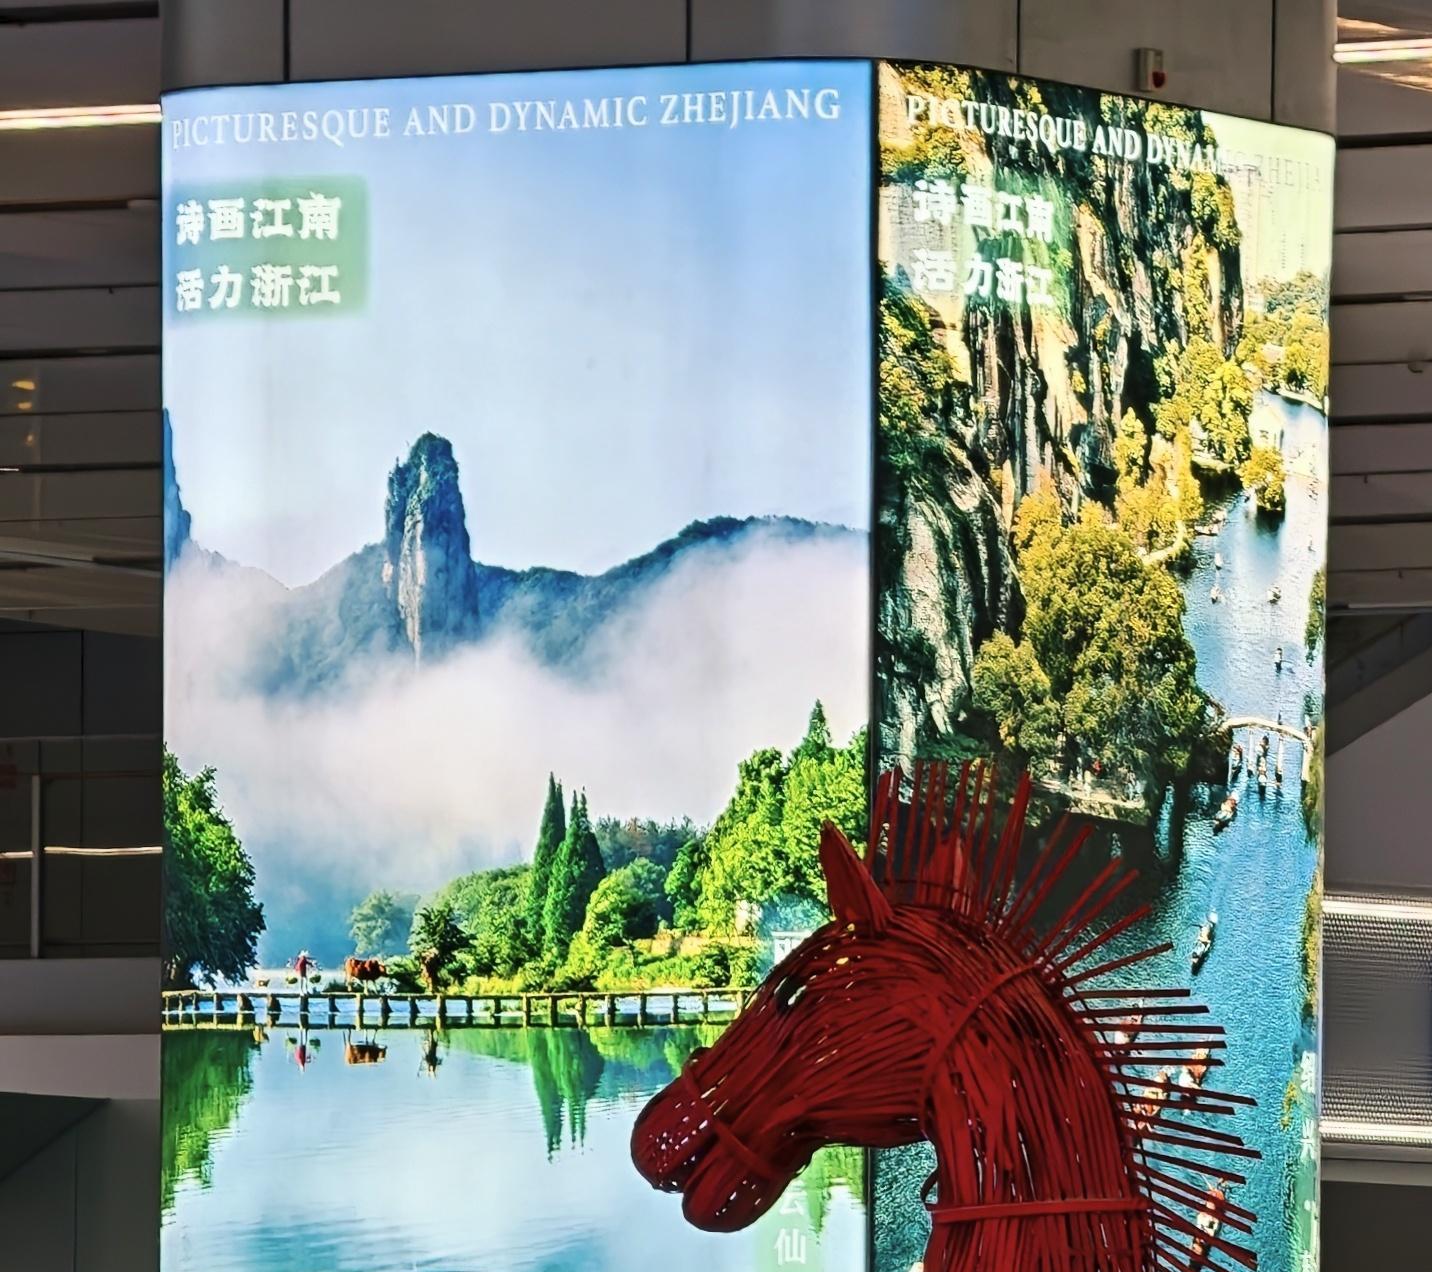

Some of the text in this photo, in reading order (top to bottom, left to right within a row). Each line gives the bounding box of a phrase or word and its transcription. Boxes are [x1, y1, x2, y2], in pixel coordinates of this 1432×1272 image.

[172, 88, 841, 149] PICTURESQUE AND DYNAMIC ZHEJIANG
[907, 94, 1087, 152] PICTURESQUE
[1092, 123, 1143, 162] AND
[175, 191, 342, 246] 诗画江南
[175, 264, 342, 312] 活力浙江
